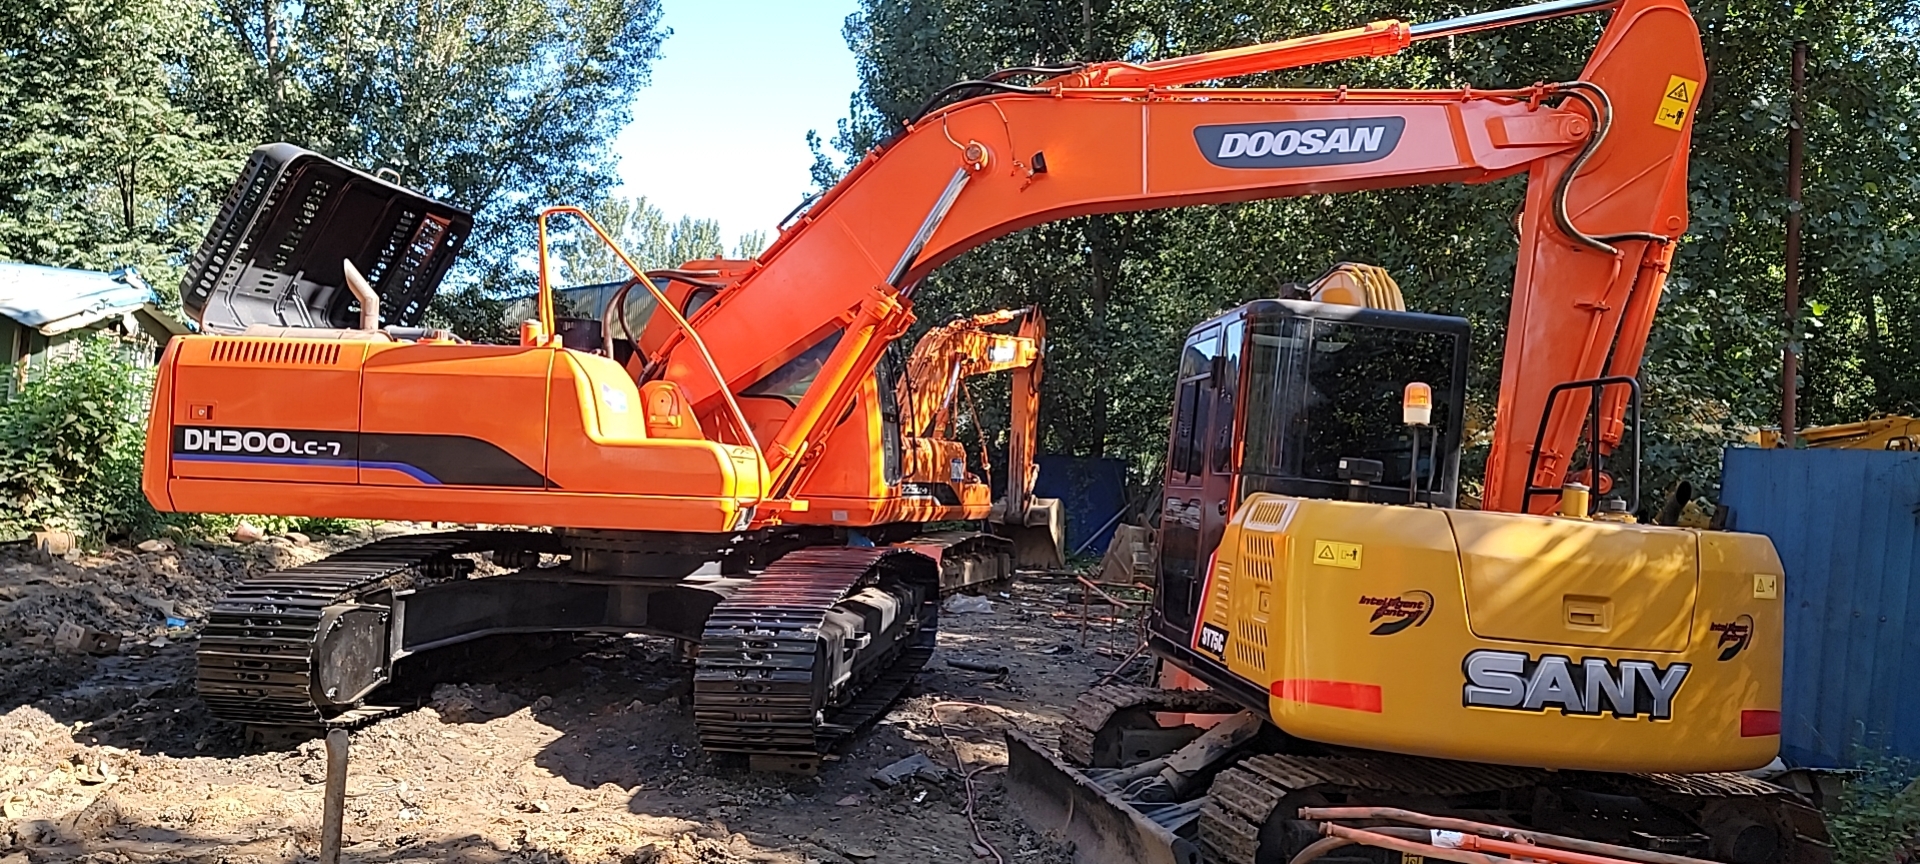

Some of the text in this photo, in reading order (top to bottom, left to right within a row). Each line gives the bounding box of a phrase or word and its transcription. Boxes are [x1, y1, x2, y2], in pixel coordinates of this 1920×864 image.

[1217, 126, 1386, 158] DOOSAN
[184, 428, 341, 456] DH300LC-7
[1359, 595, 1425, 609] Intelligent
[1463, 650, 1691, 719] SANY
